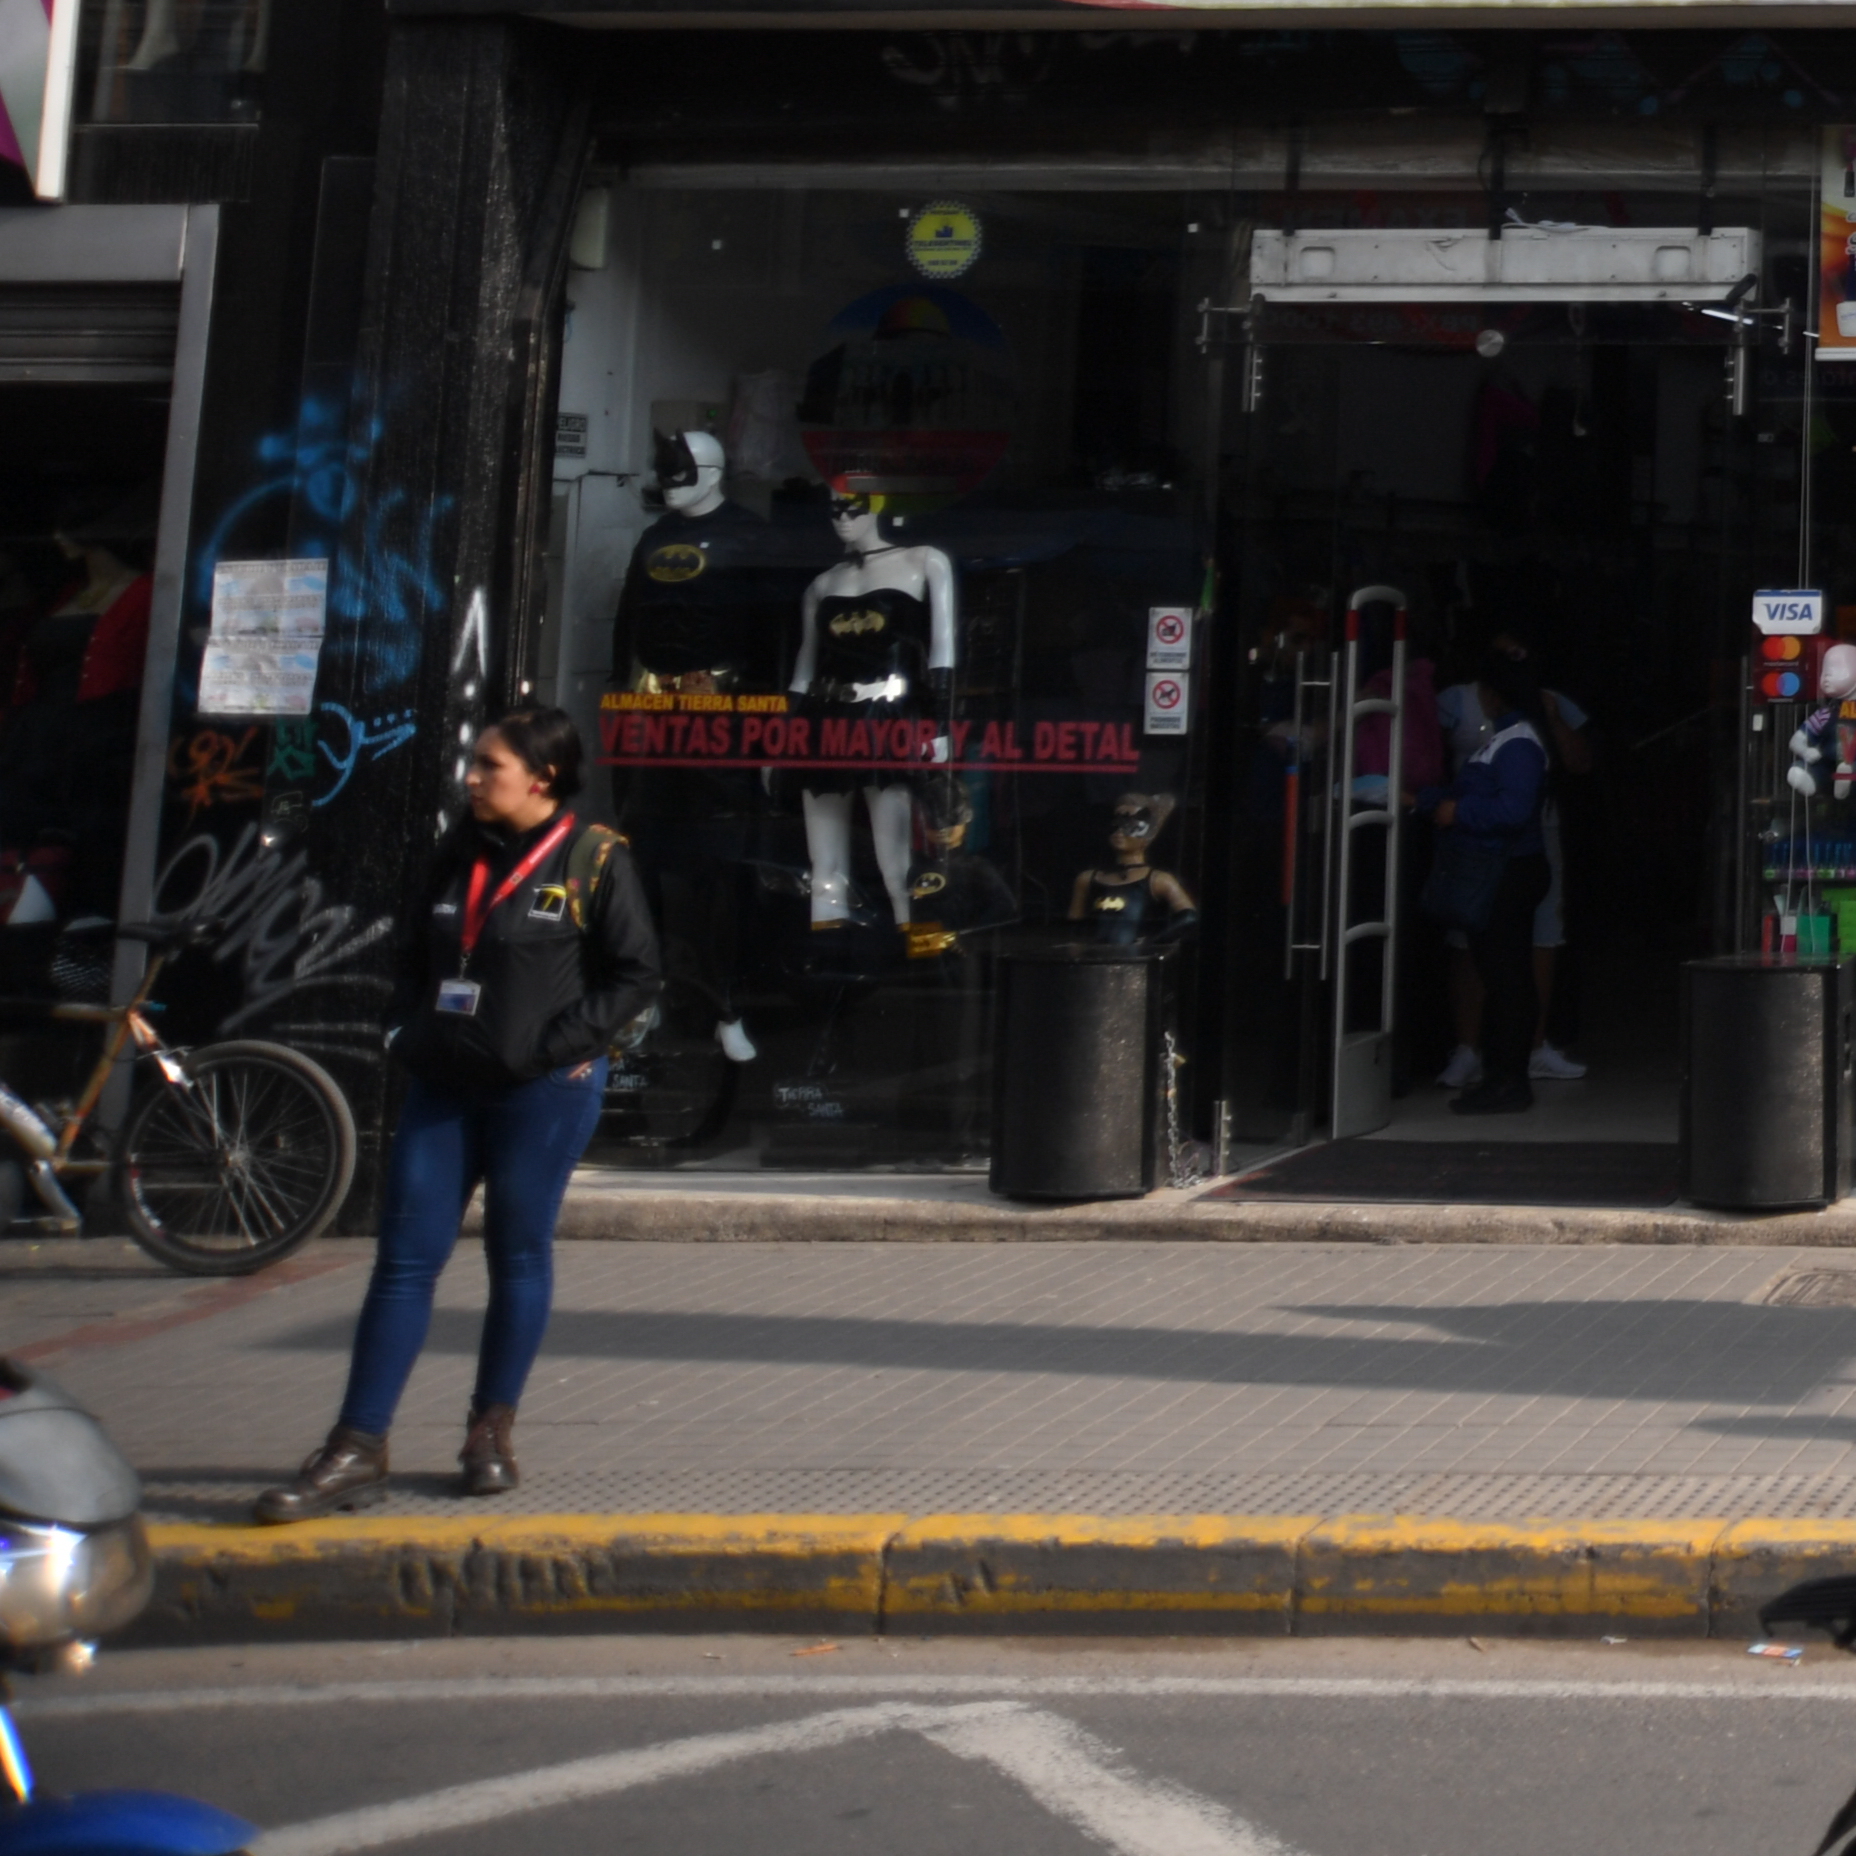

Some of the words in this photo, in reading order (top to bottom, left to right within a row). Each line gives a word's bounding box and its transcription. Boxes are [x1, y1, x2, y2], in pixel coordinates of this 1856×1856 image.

[1763, 603, 1813, 621] VISA
[601, 693, 675, 712] ALMACEN
[678, 694, 734, 713] TIERRA
[736, 695, 788, 714] SANTA
[599, 715, 730, 756] VENTAS
[741, 717, 810, 757] POR
[819, 717, 936, 760] MAYOR
[948, 719, 973, 759] Y
[982, 721, 1023, 760] AL
[1033, 721, 1141, 762] DETAL
